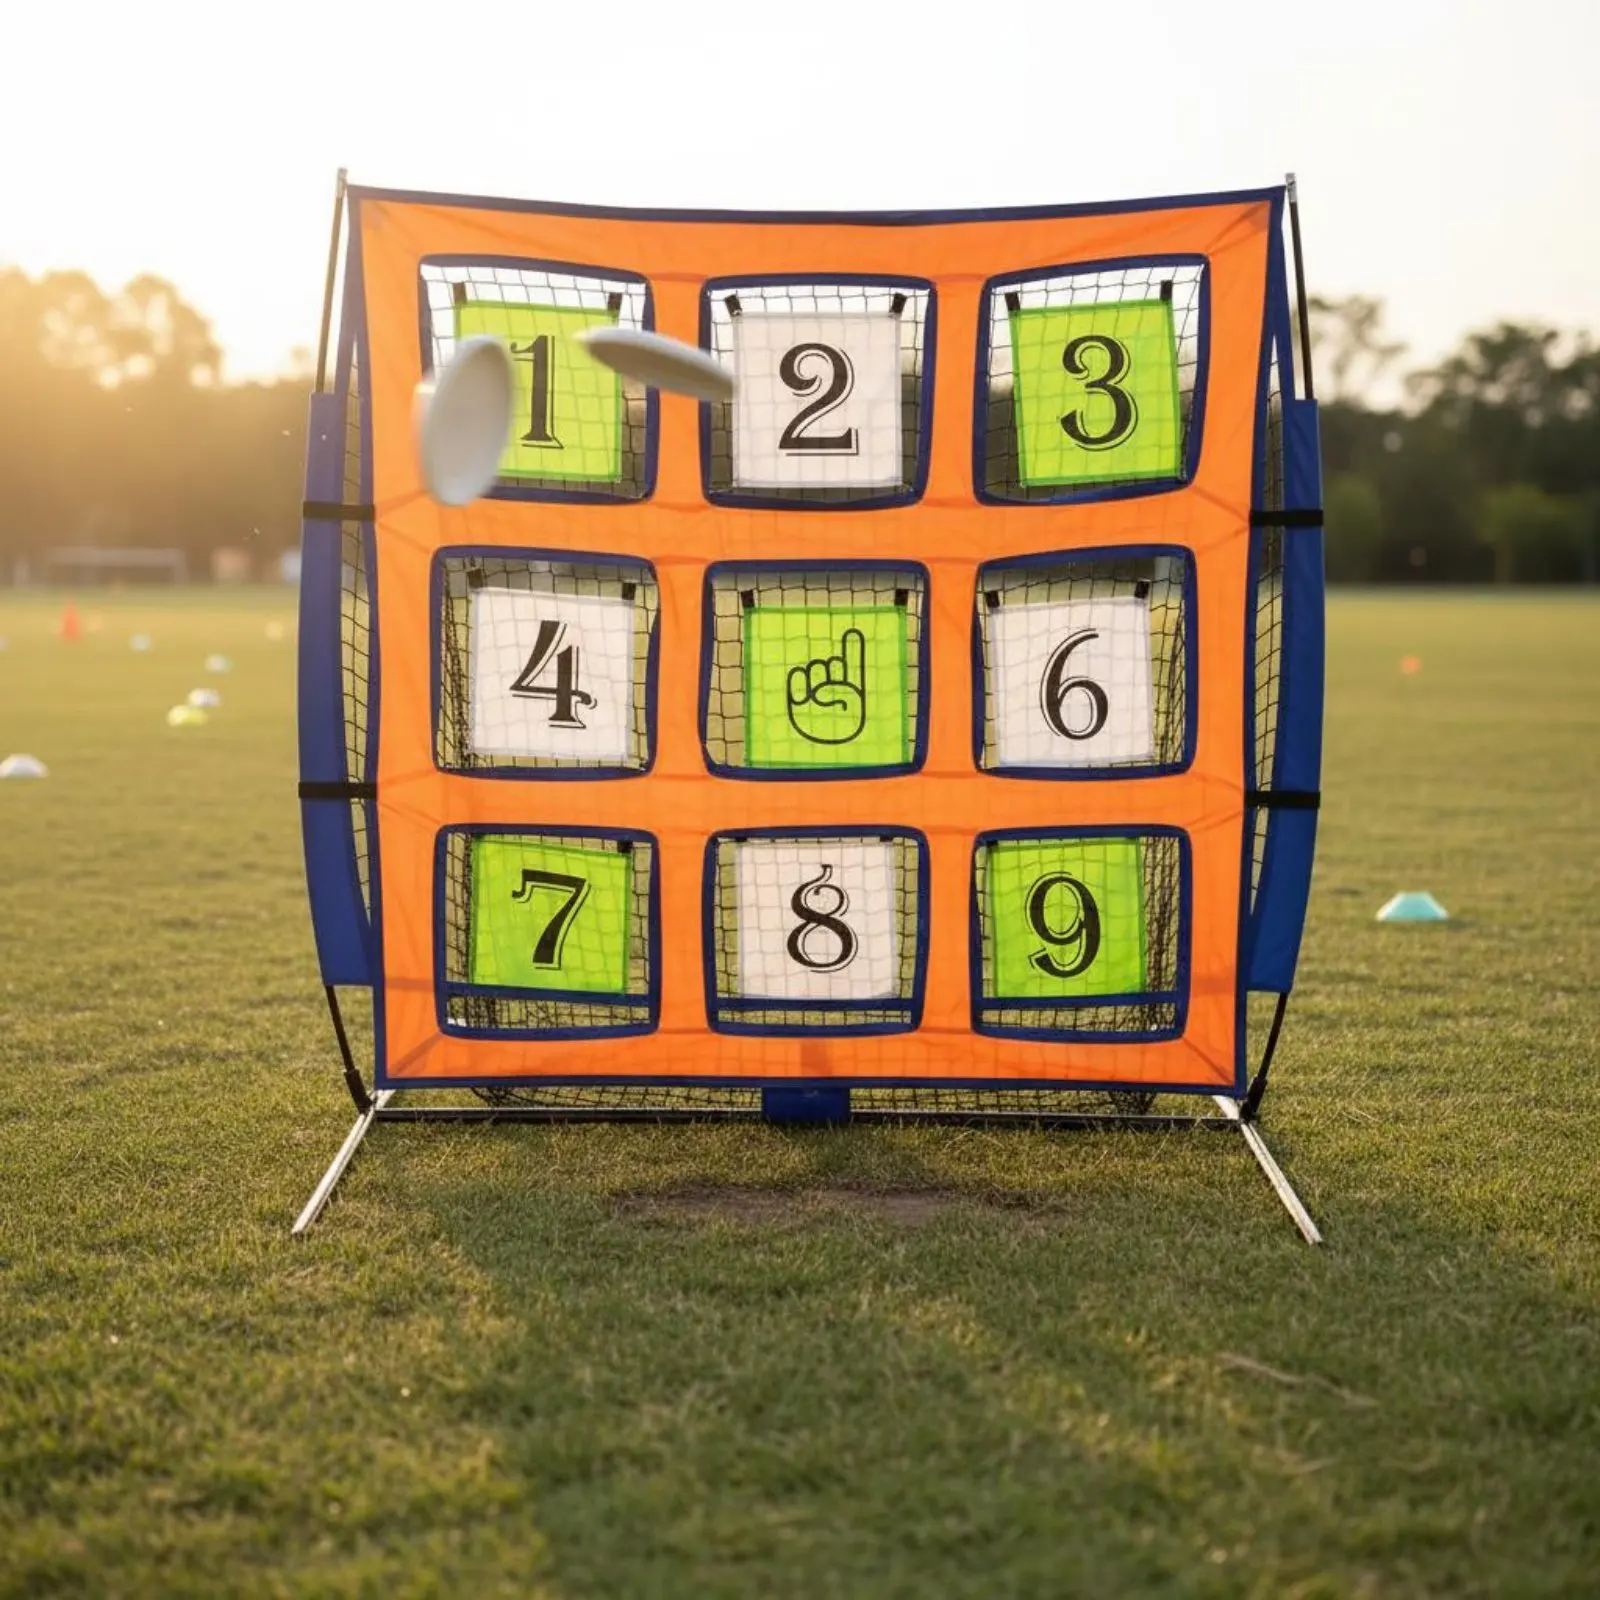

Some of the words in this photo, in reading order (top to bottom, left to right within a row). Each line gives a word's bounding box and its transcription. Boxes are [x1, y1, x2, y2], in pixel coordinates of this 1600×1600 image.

[510, 335, 564, 449] 1
[778, 342, 859, 456] 2
[1060, 334, 1141, 450] 3
[510, 620, 599, 729] 4
[1040, 628, 1109, 740] 6
[511, 869, 592, 970] 7
[787, 864, 858, 973] 8
[1027, 871, 1102, 978] 9
